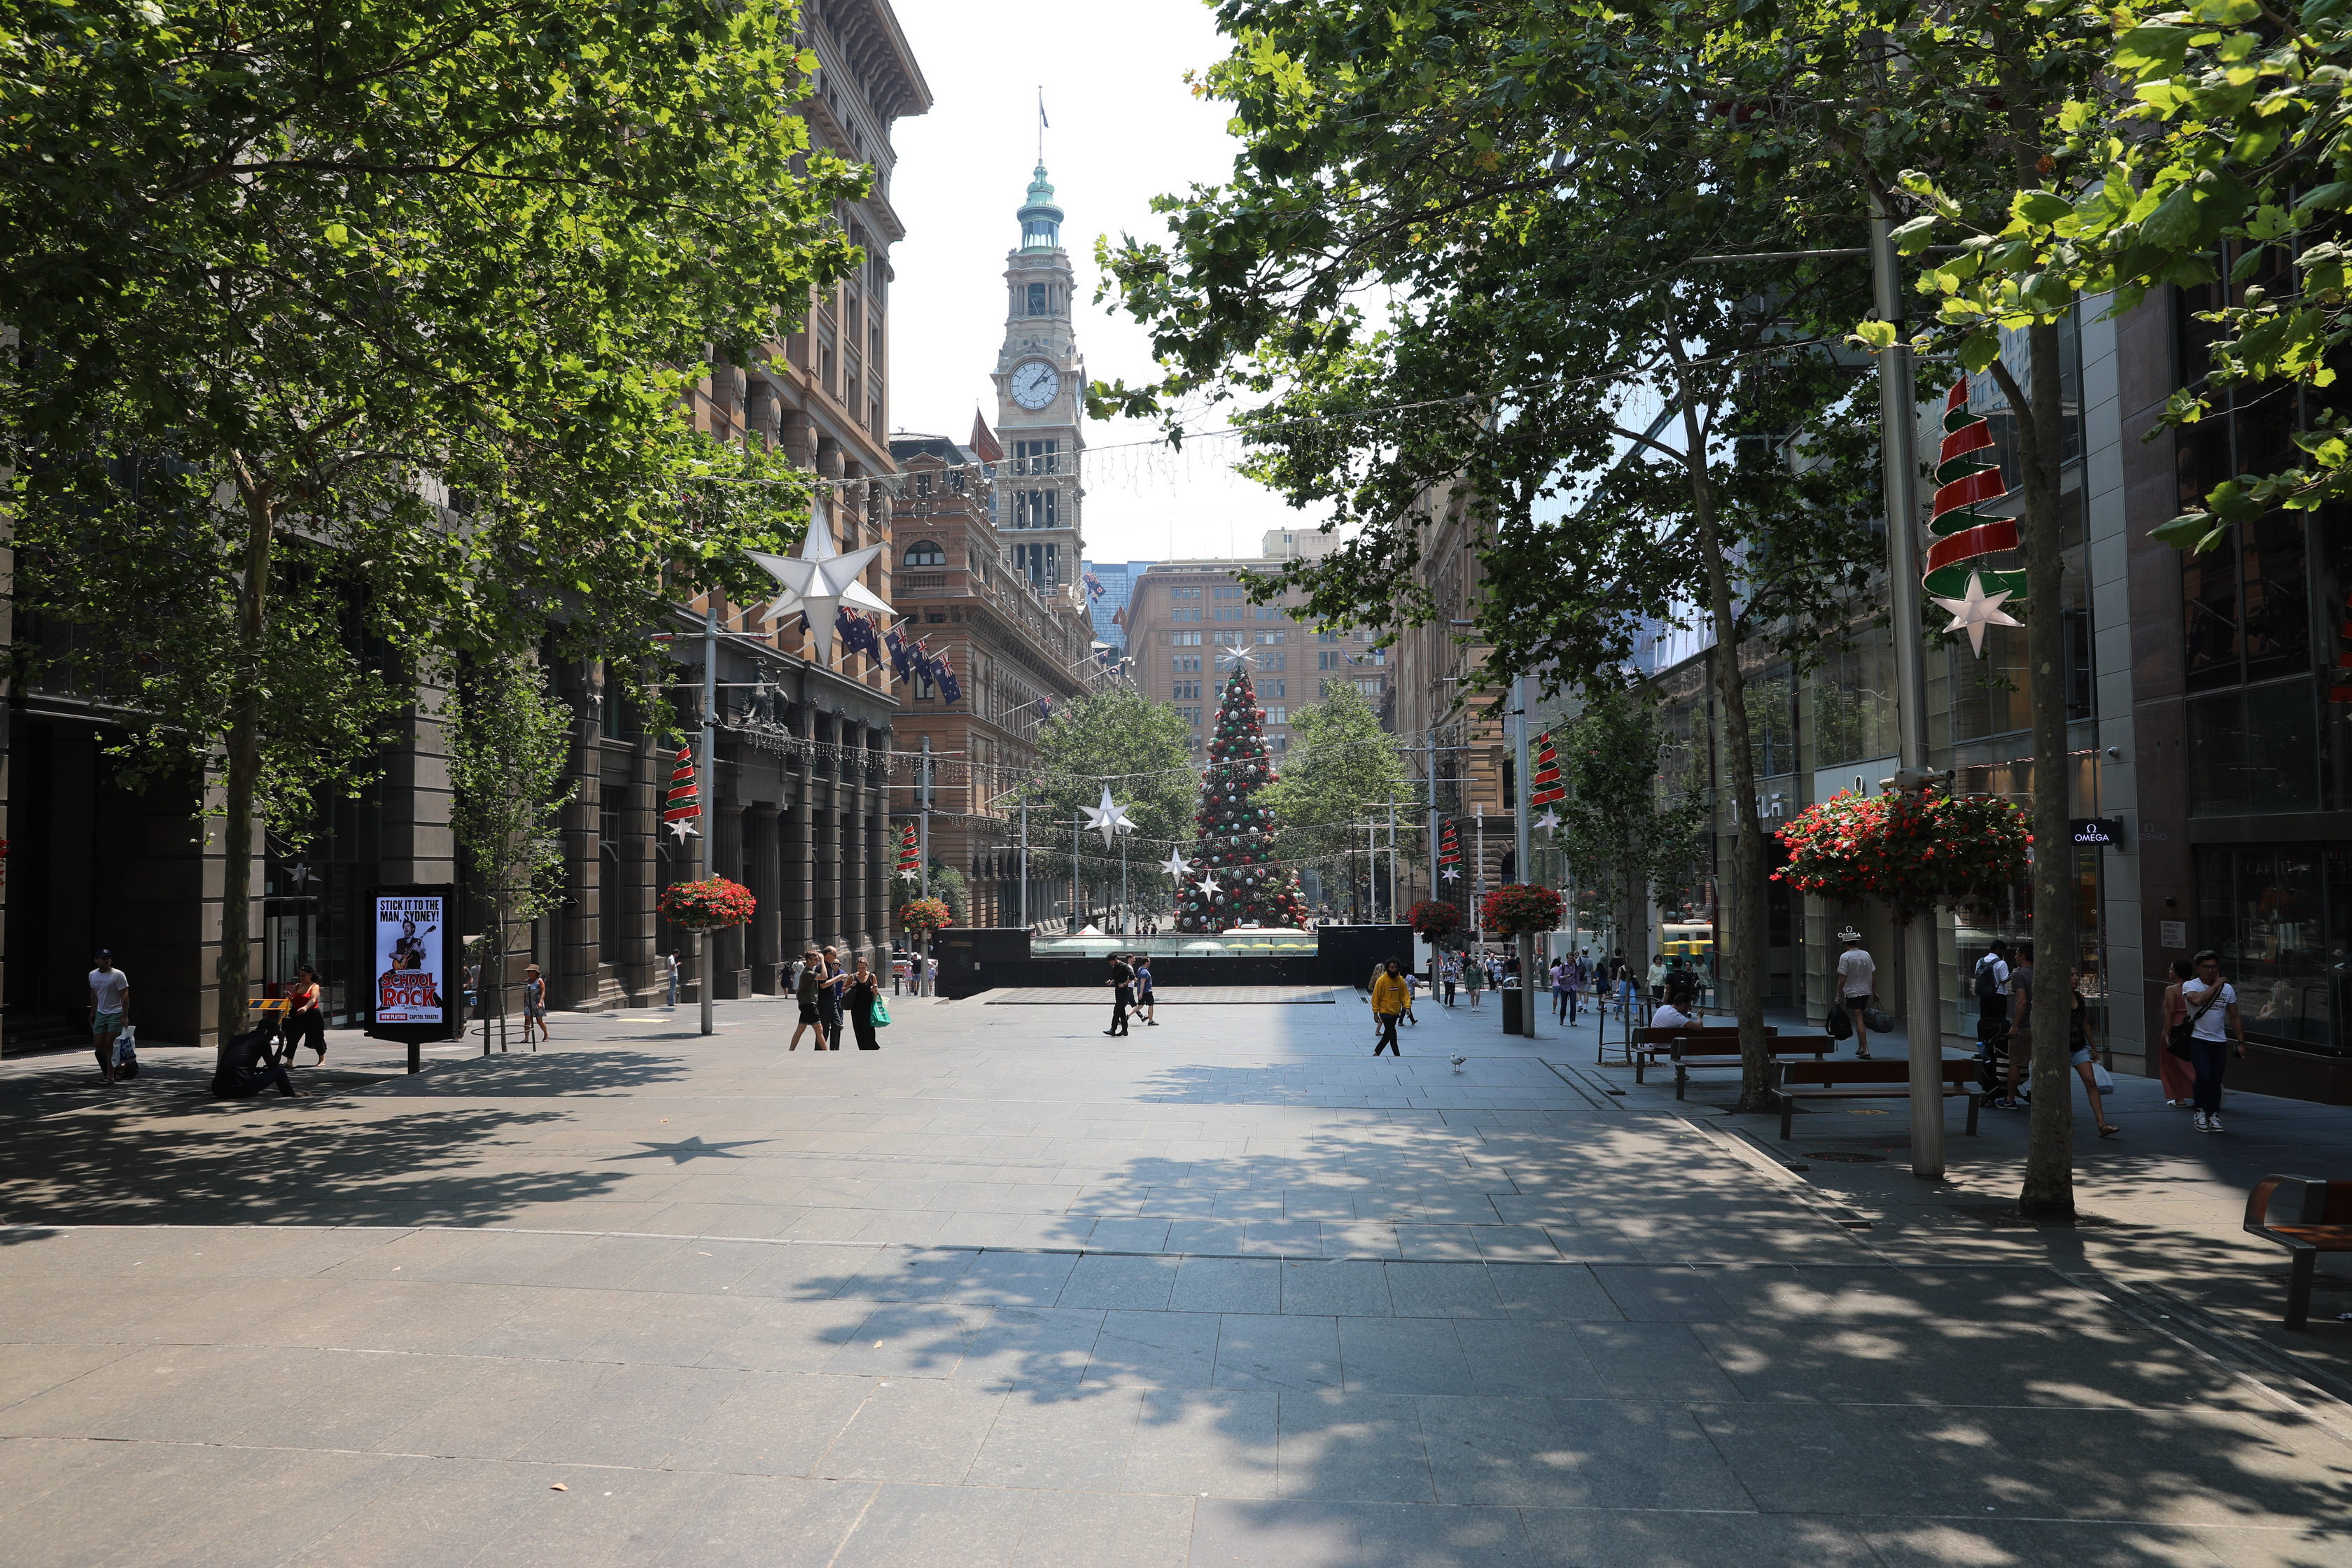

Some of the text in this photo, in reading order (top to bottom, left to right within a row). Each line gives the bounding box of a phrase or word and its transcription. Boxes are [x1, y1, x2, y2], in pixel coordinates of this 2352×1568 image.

[980, 427, 1002, 453] FULLERTON
[2074, 834, 2110, 842] OMEGA
[380, 899, 440, 911] STICK IT TO THE
[380, 911, 440, 923] MAN, SYDNEY!
[382, 972, 438, 988] SCHOOL
[404, 985, 414, 995] of
[382, 988, 438, 1007] ROCK
